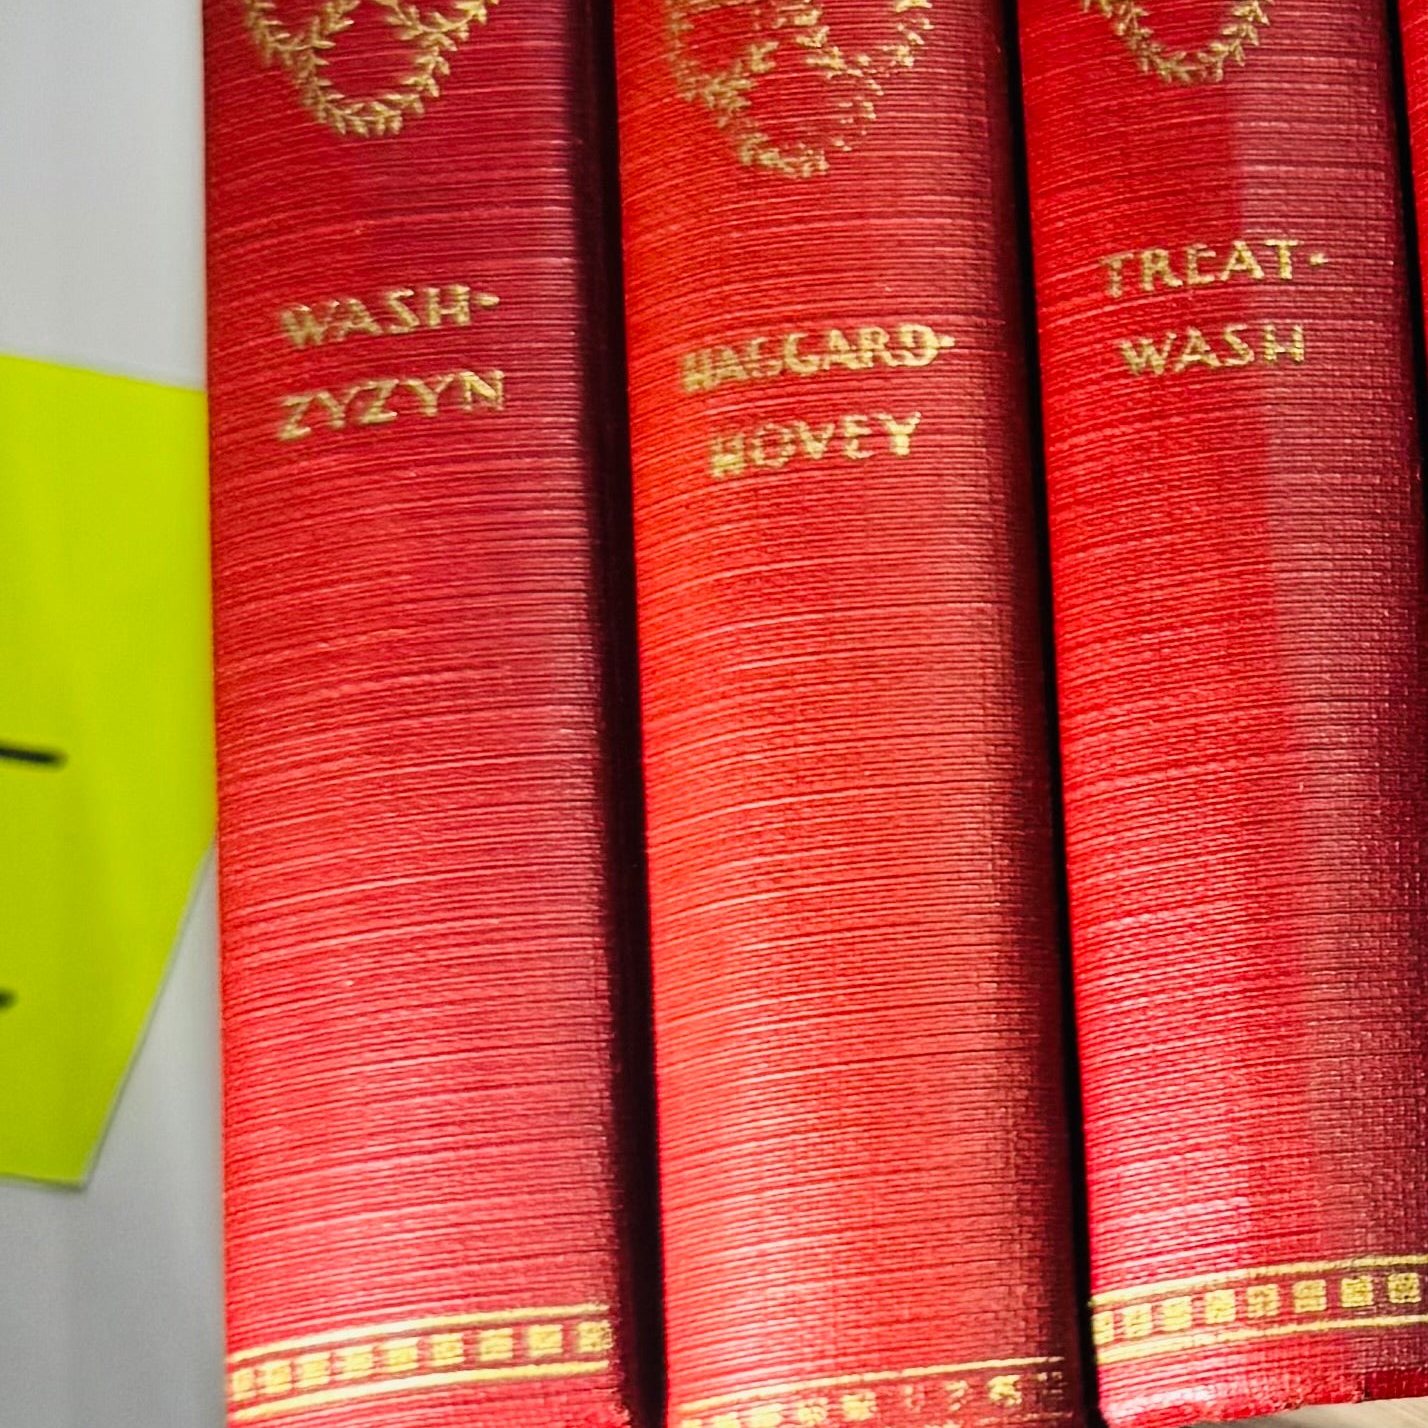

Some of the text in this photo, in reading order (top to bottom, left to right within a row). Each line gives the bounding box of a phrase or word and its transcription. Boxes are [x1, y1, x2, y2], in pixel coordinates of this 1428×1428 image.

[1100, 238, 1328, 298] TREAT-
[280, 284, 500, 349] WASH-
[680, 323, 956, 394] HAGGARD-
[1119, 324, 1305, 376] WASH
[279, 369, 505, 441] ZYZYN
[710, 411, 922, 479] HOVEY
